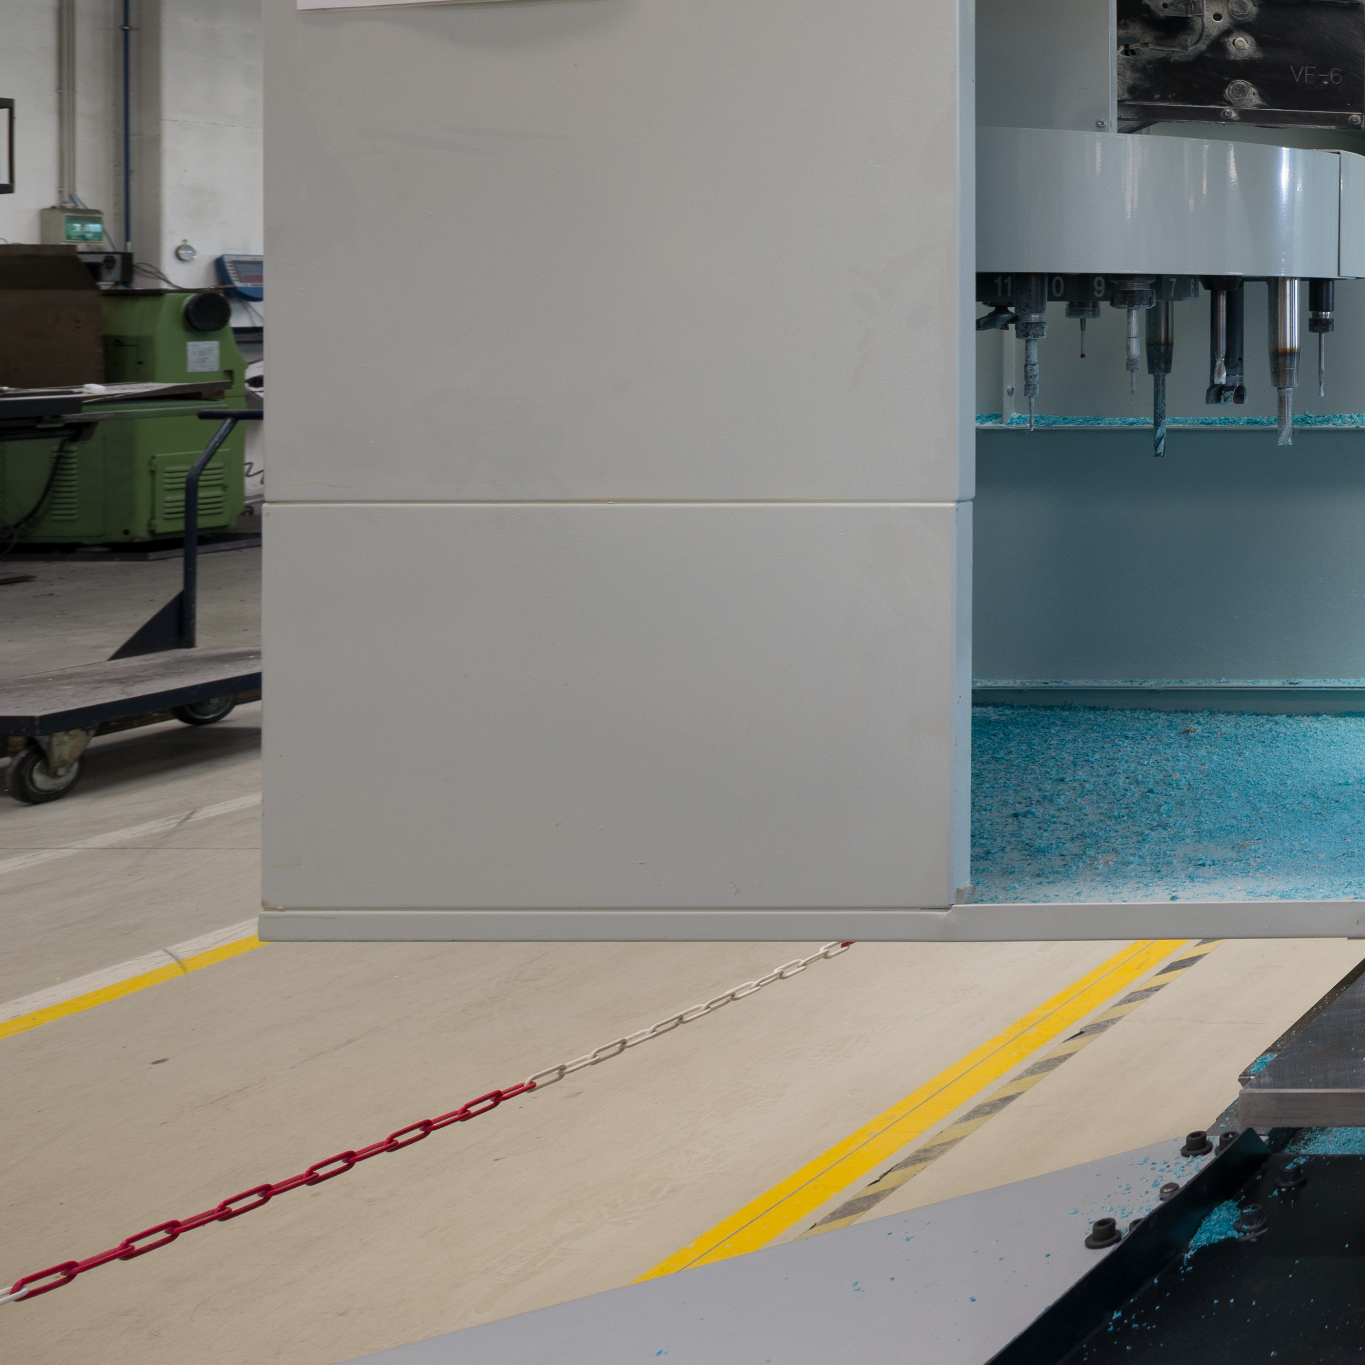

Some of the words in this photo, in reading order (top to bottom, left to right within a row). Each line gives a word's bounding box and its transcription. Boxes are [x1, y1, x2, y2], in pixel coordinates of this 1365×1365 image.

[1289, 65, 1343, 85] VF-6
[993, 276, 1012, 297] 11
[1093, 276, 1106, 298] 9
[1169, 278, 1177, 297] 7
